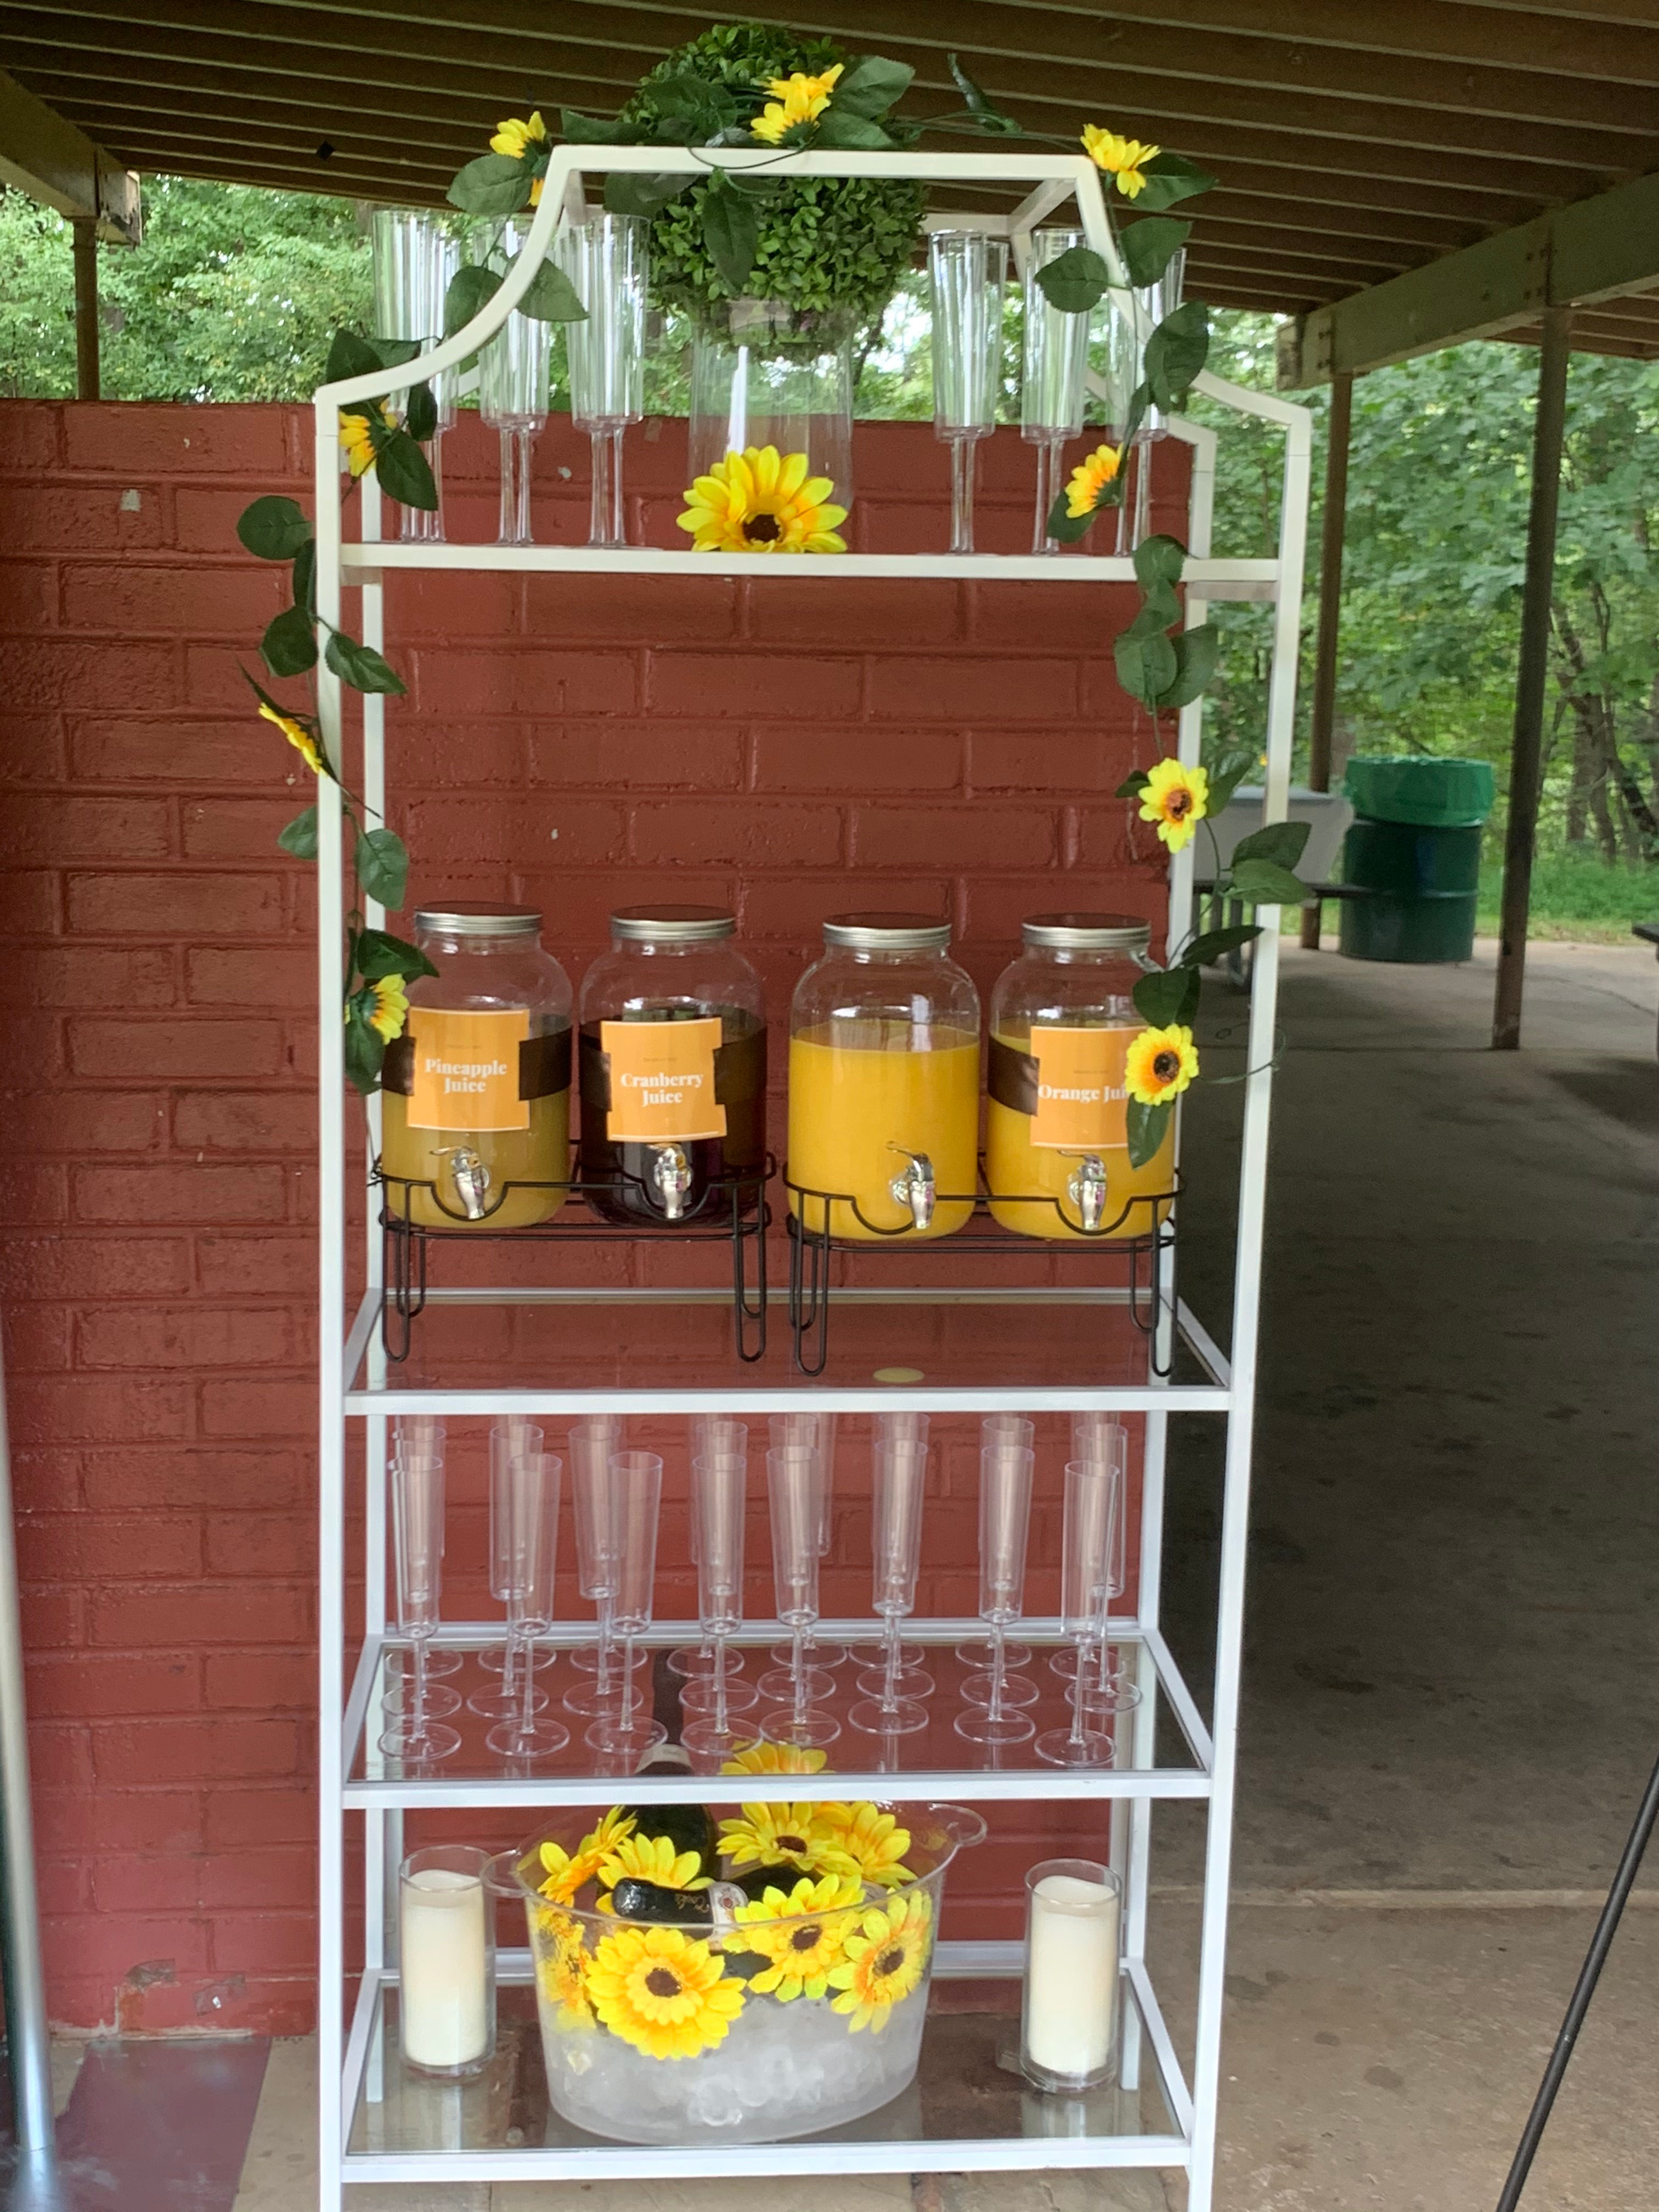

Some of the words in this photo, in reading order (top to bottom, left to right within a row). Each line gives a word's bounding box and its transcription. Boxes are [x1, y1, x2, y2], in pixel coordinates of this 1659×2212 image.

[425, 1058, 507, 1078] Pineapple
[444, 1077, 486, 1094] Juice
[620, 1073, 703, 1088] Cranberry
[642, 1089, 683, 1107] Juice
[1037, 1085, 1099, 1103] Orange
[1104, 1084, 1127, 1103] Jui
